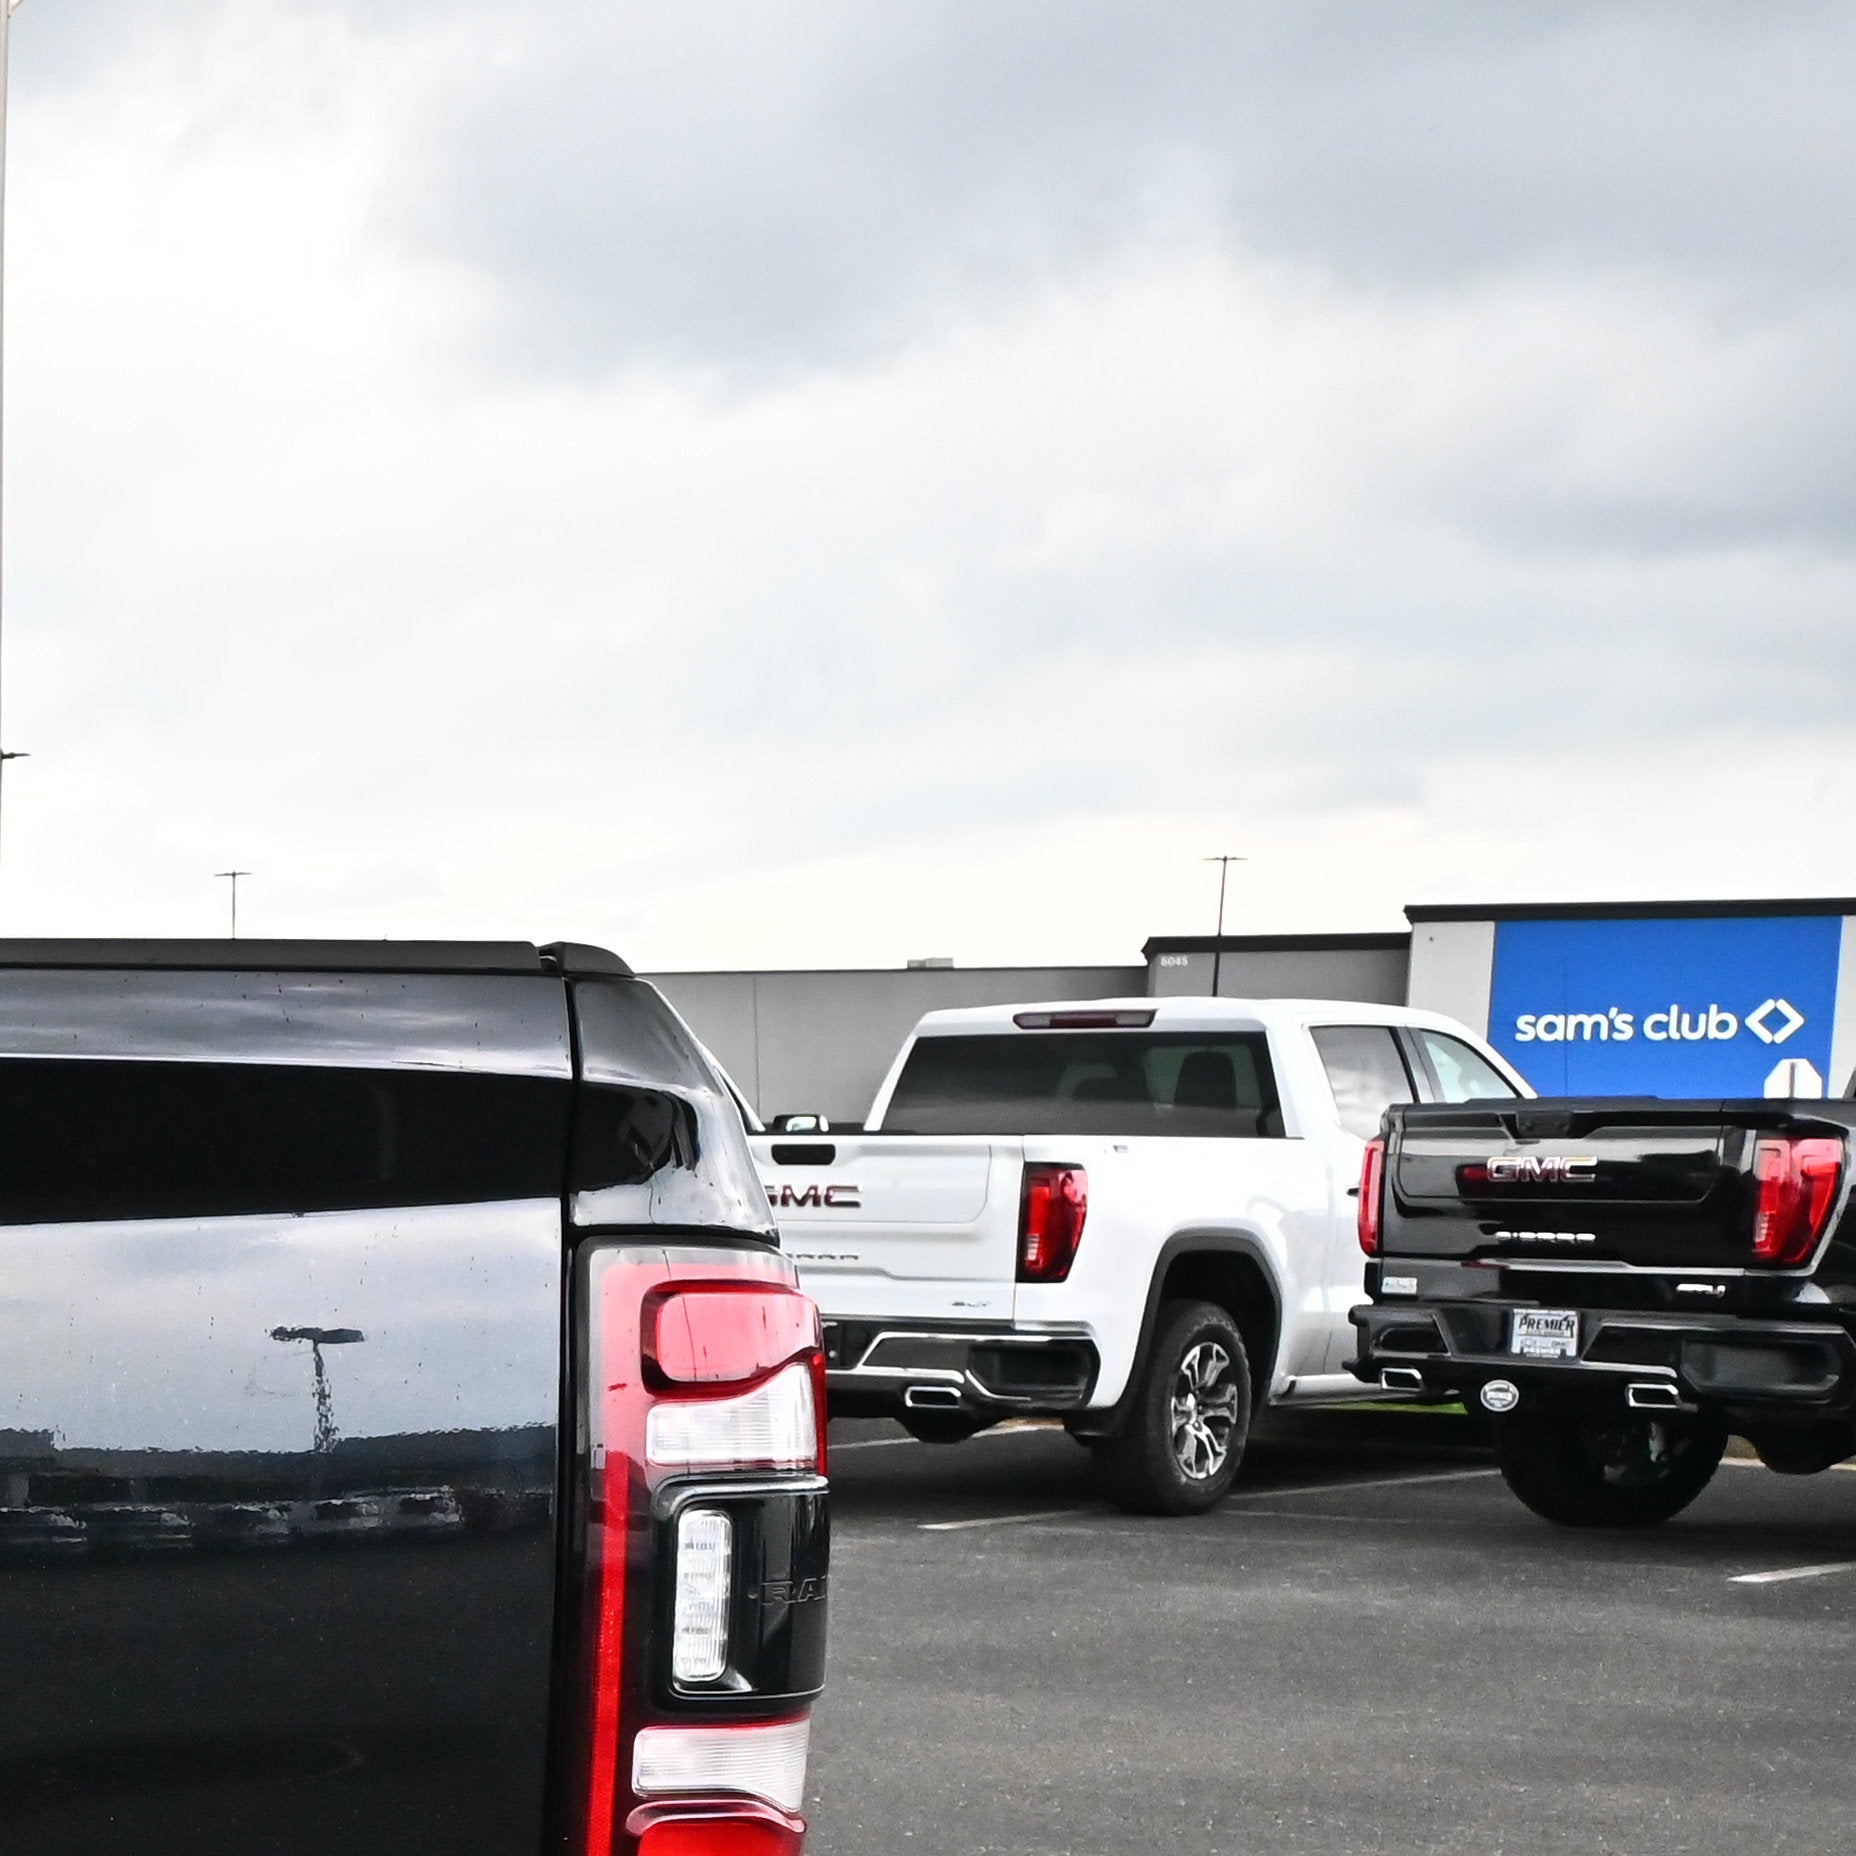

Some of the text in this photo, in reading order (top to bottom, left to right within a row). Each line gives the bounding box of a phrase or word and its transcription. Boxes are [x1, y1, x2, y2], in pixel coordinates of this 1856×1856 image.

[1514, 1003, 1739, 1042] sam's club
[1487, 1156, 1598, 1182] GMC
[1519, 1317, 1575, 1337] PREMIER
